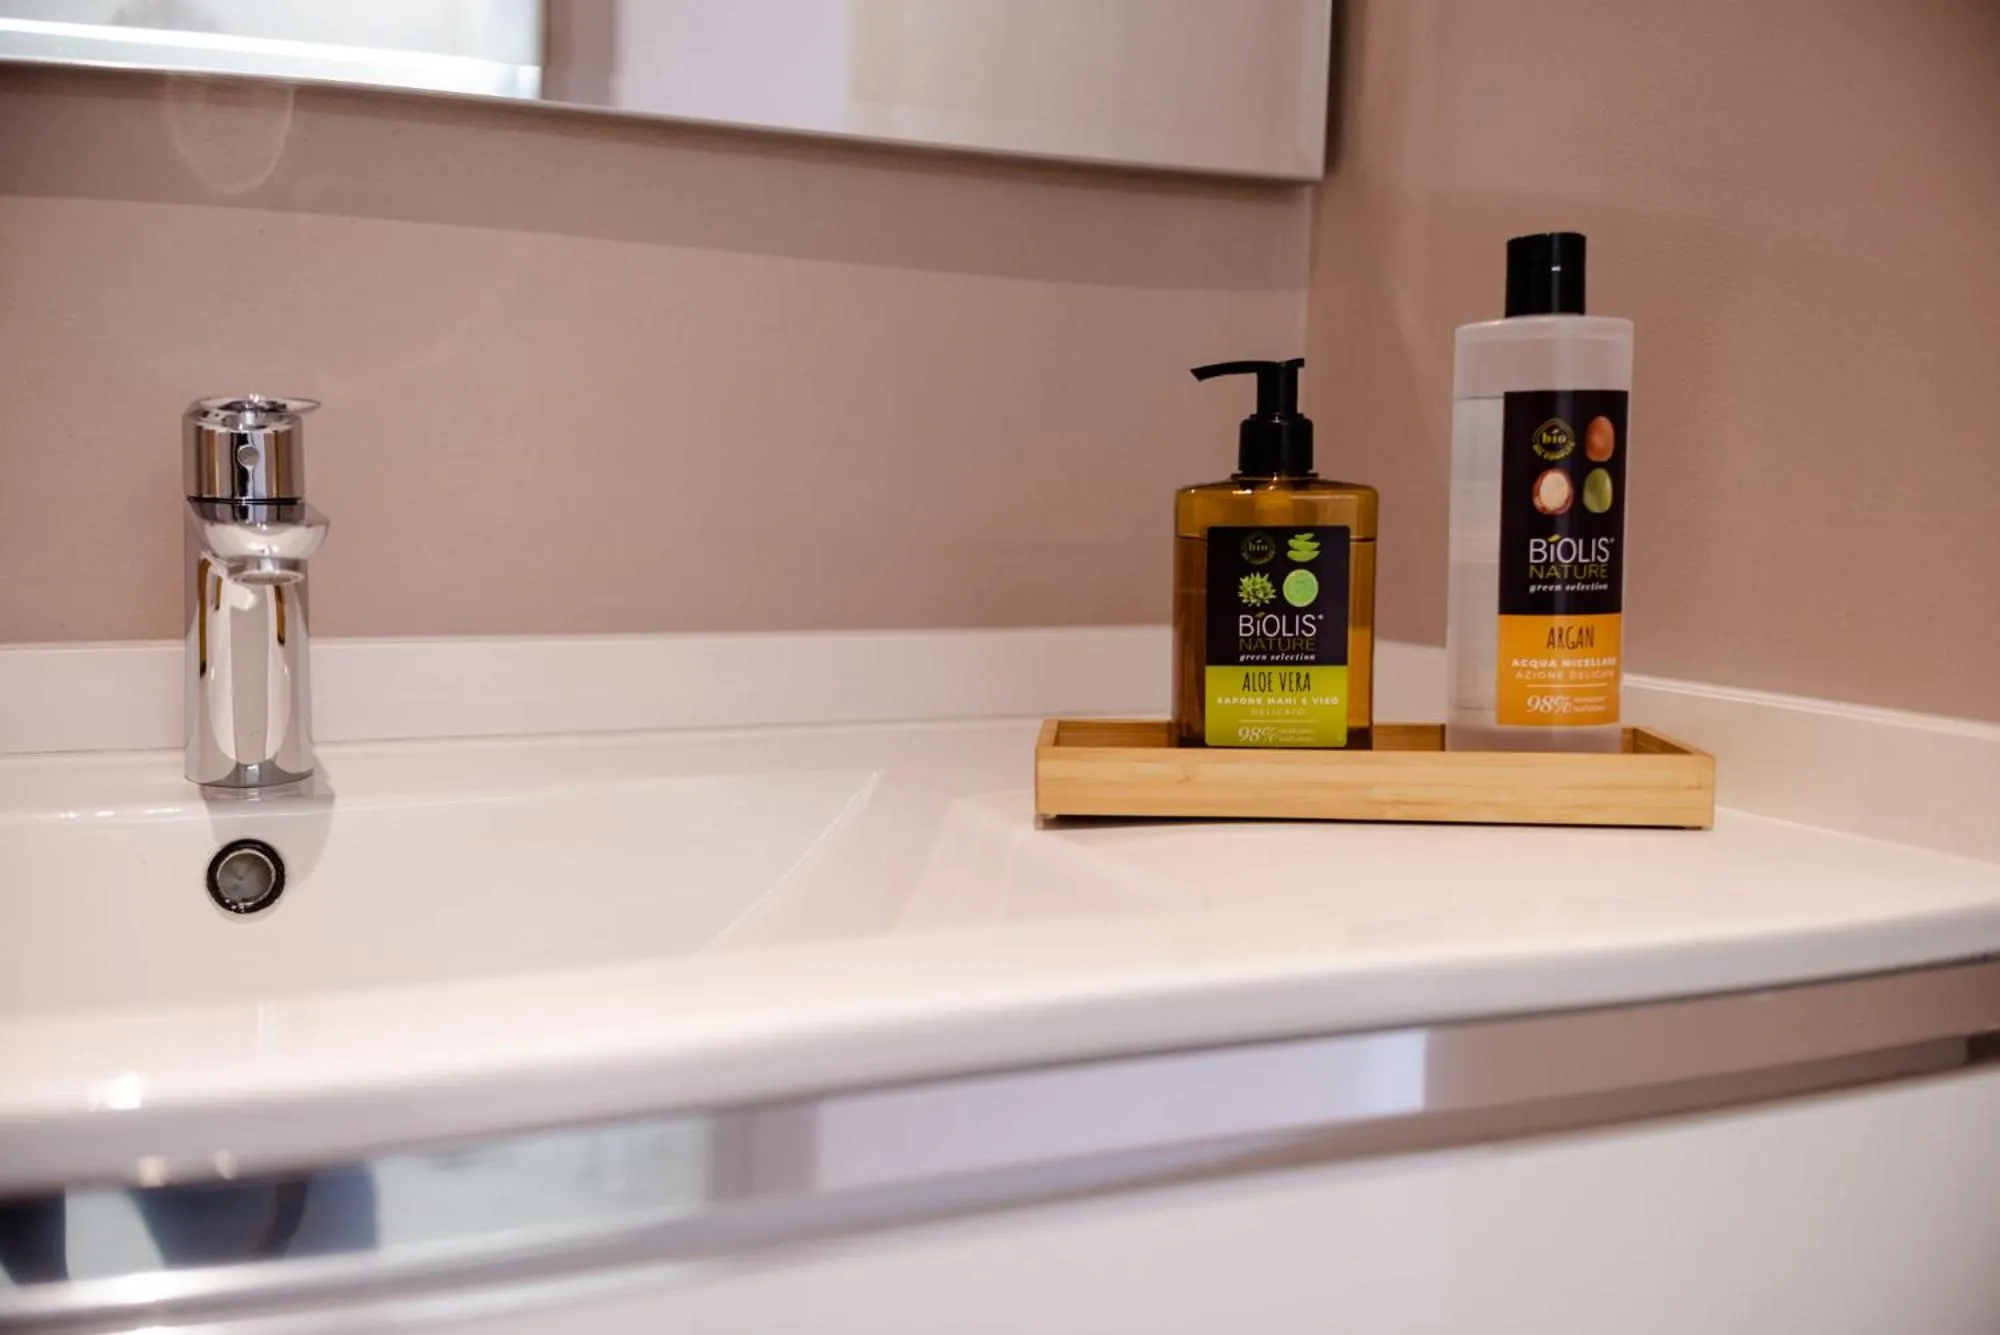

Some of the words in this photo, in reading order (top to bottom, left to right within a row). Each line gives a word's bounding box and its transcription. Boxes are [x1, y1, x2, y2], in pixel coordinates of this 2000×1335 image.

[1542, 429, 1567, 444] bio
[1529, 564, 1608, 579] NATURE
[1529, 584, 1562, 594] green
[1565, 581, 1609, 592] selection
[1546, 625, 1594, 649] ARGAN
[1240, 638, 1316, 651] NATURE
[1239, 653, 1267, 662] green
[1270, 652, 1316, 661] selection
[1512, 658, 1557, 669] ACQUA
[1515, 669, 1564, 680] AZIONE
[1242, 671, 1273, 692] ALOE
[1279, 671, 1311, 692] VERA
[1217, 696, 1263, 705] SAPONE
[1312, 696, 1339, 705] VISO
[1526, 694, 1573, 714] 98%
[1250, 707, 1305, 716] DELICATO
[1237, 725, 1277, 743] 98%
